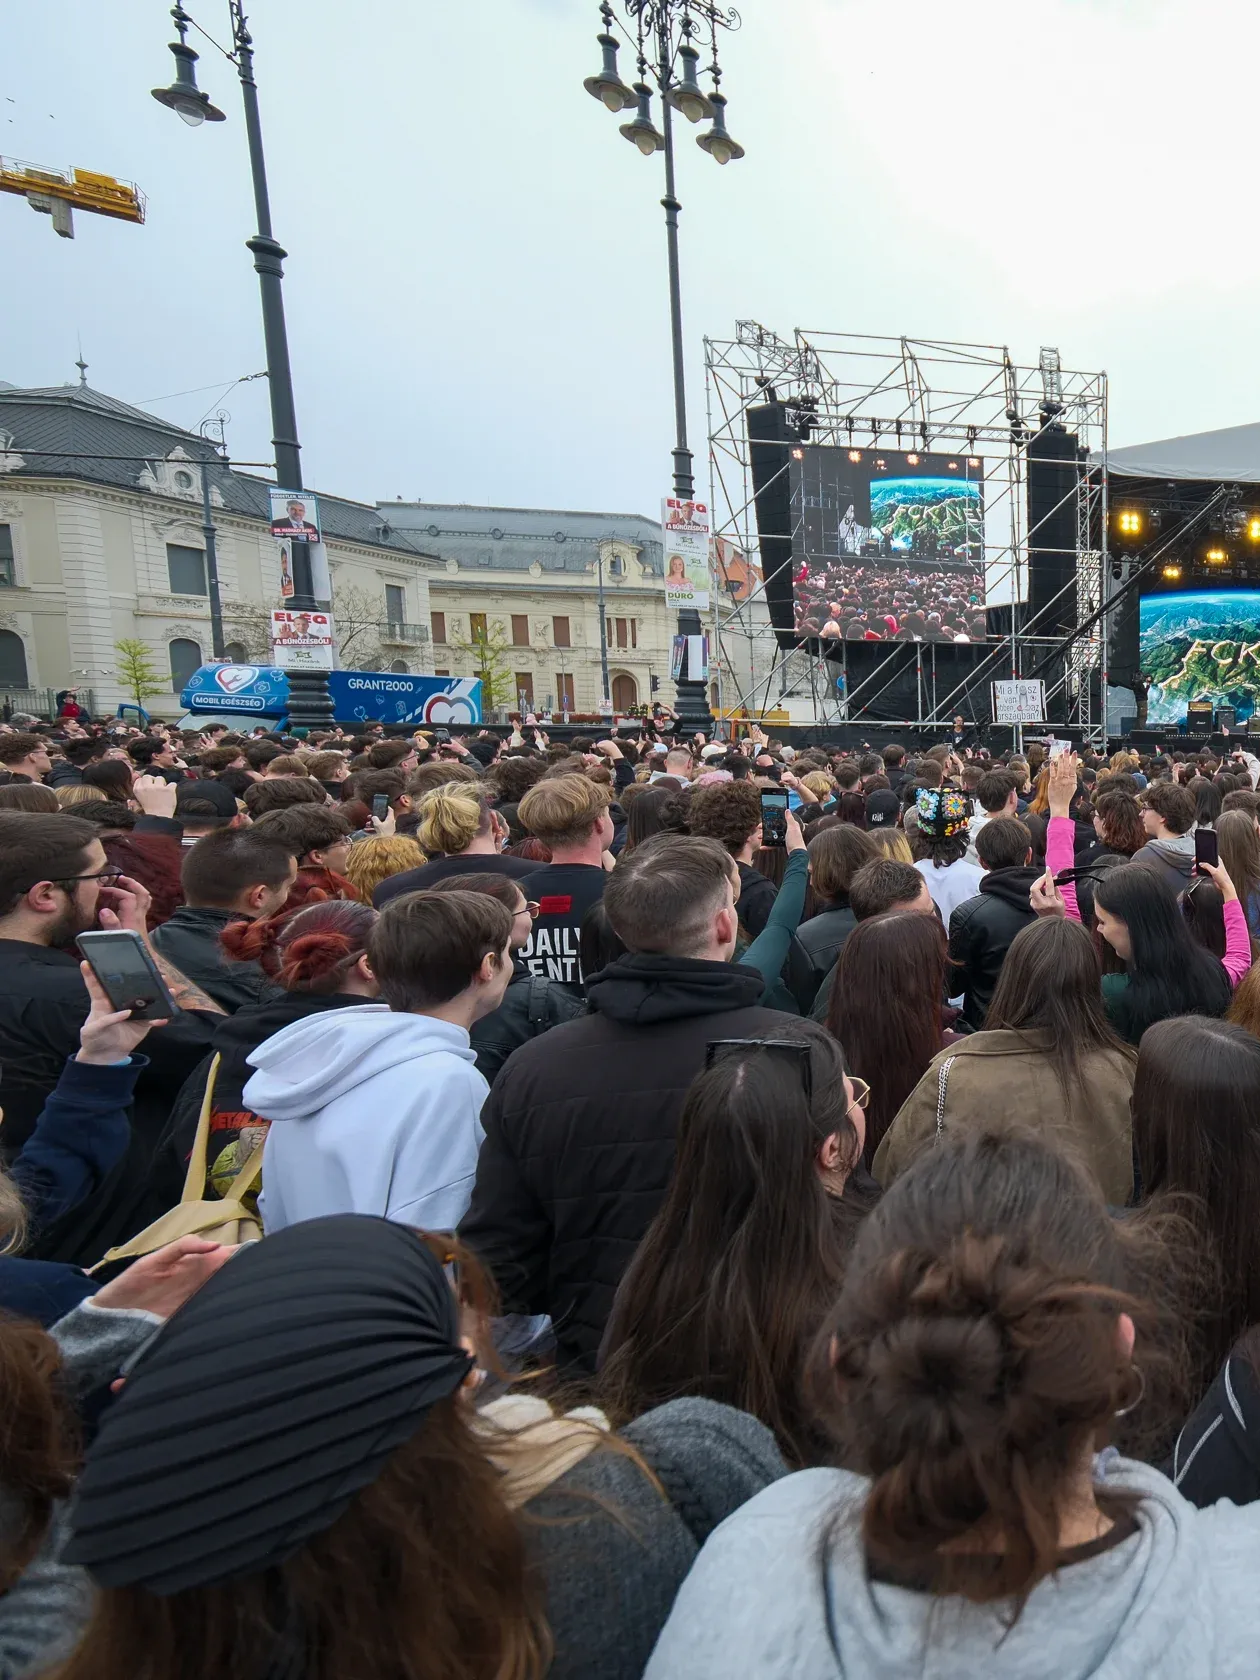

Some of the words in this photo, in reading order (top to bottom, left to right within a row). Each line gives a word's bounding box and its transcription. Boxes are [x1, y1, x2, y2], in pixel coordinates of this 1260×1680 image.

[348, 678, 413, 691] GRANT2000
[1007, 686, 1013, 695] a
[221, 698, 260, 706] EGÉSZSÉG
